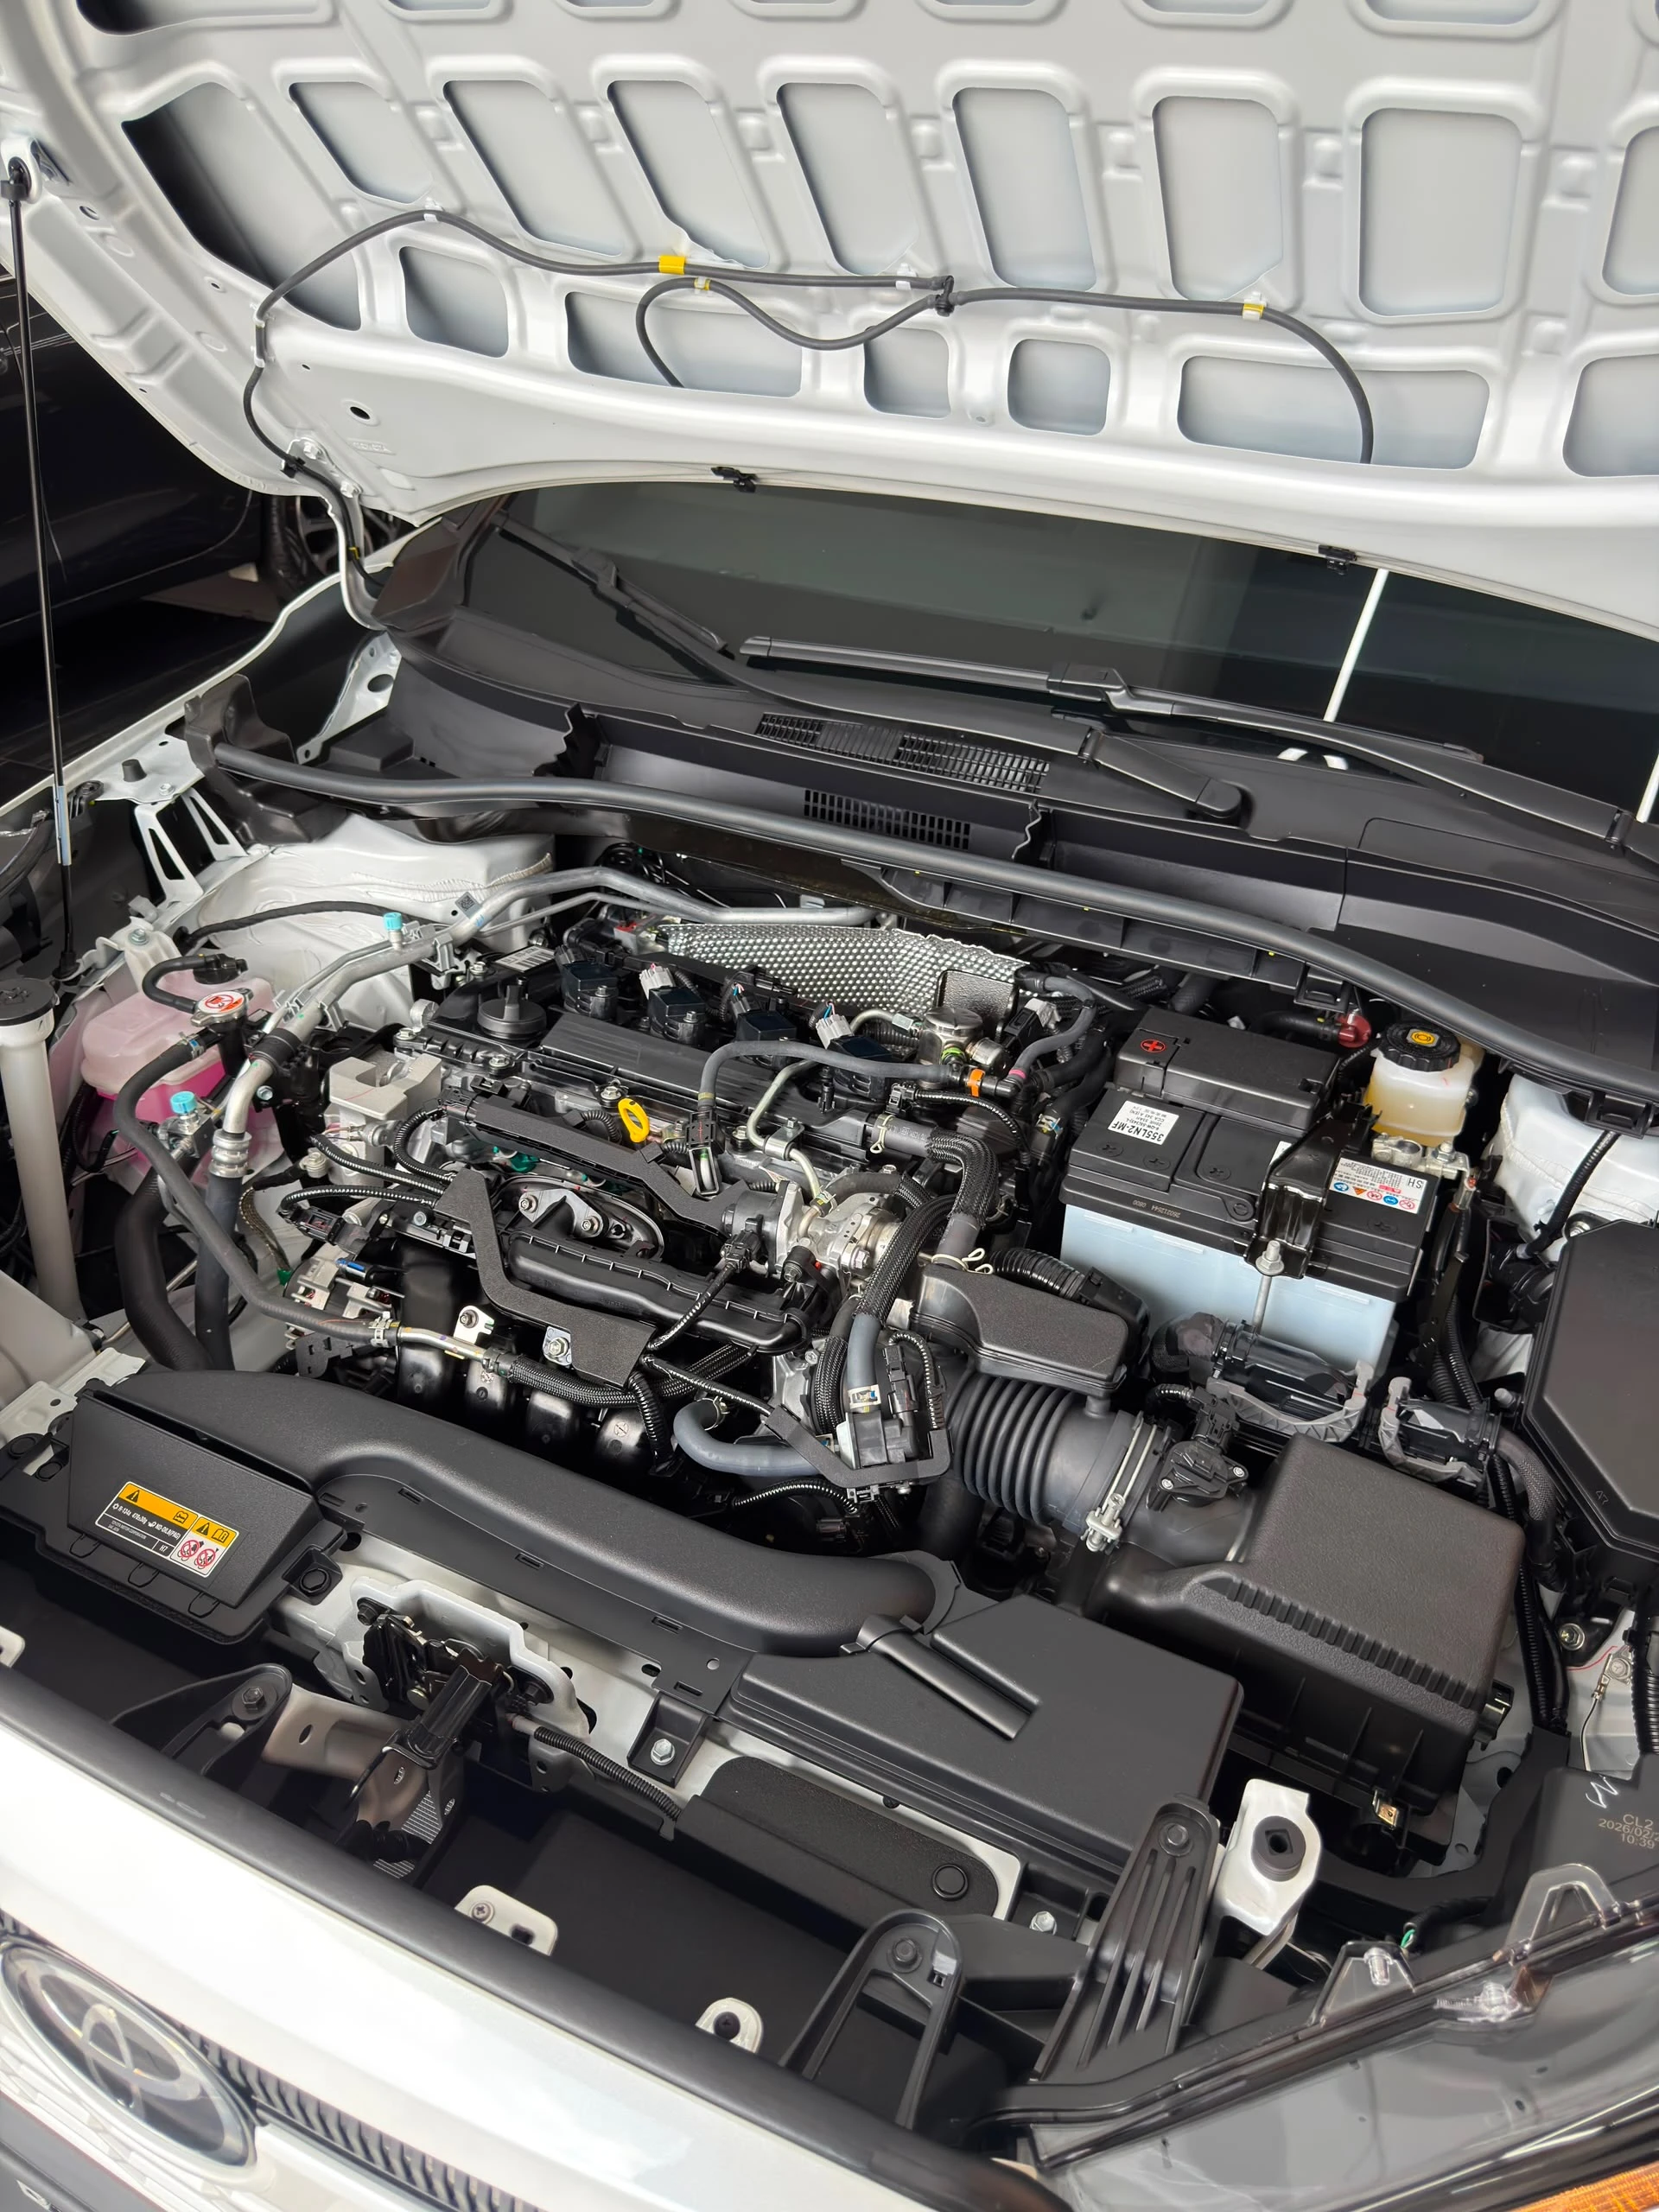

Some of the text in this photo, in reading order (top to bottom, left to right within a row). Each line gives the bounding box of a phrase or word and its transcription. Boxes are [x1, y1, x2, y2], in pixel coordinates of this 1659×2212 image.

[1111, 1121, 1164, 1141] 355LN2-MF
[1407, 1178, 1423, 1189] SH
[159, 1544, 168, 1553] H7
[1623, 1814, 1654, 1830] CL2
[1621, 1833, 1655, 1849] 10:39
